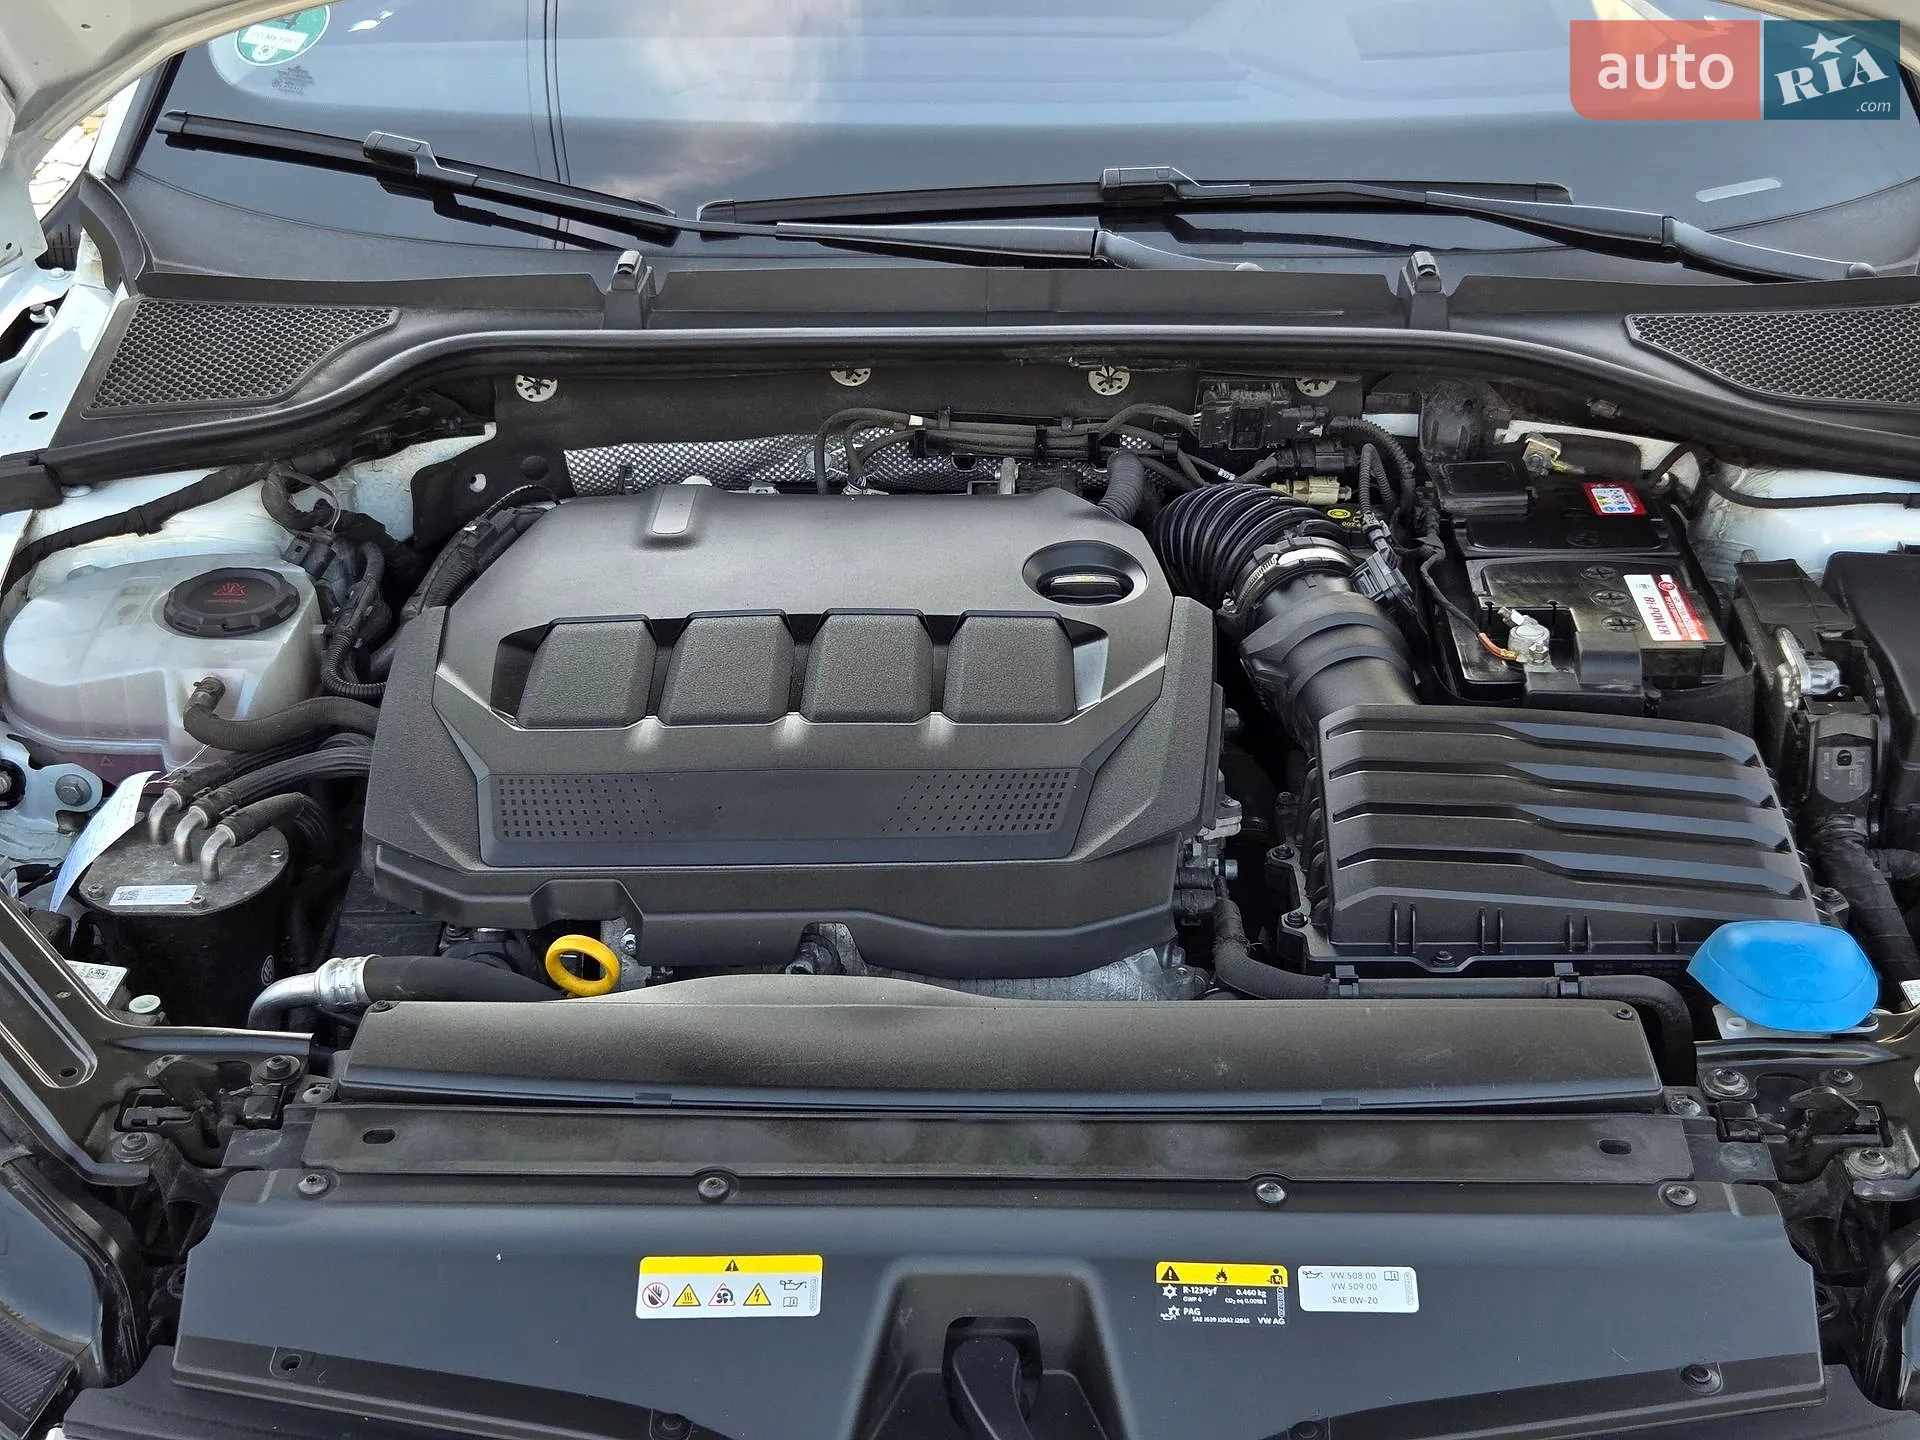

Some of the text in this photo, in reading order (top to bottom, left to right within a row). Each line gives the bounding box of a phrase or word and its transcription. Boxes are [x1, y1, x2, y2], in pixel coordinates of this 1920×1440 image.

[1330, 1271, 1377, 1280] VW 508 00
[1182, 1286, 1217, 1296] R-1234yf
[1331, 1282, 1378, 1291] VW 509 00
[1235, 1288, 1267, 1298] 0.460 kg
[1331, 1296, 1379, 1305] SAE 0W-20
[1183, 1307, 1201, 1316] PAG
[1257, 1317, 1286, 1326] VW AG
